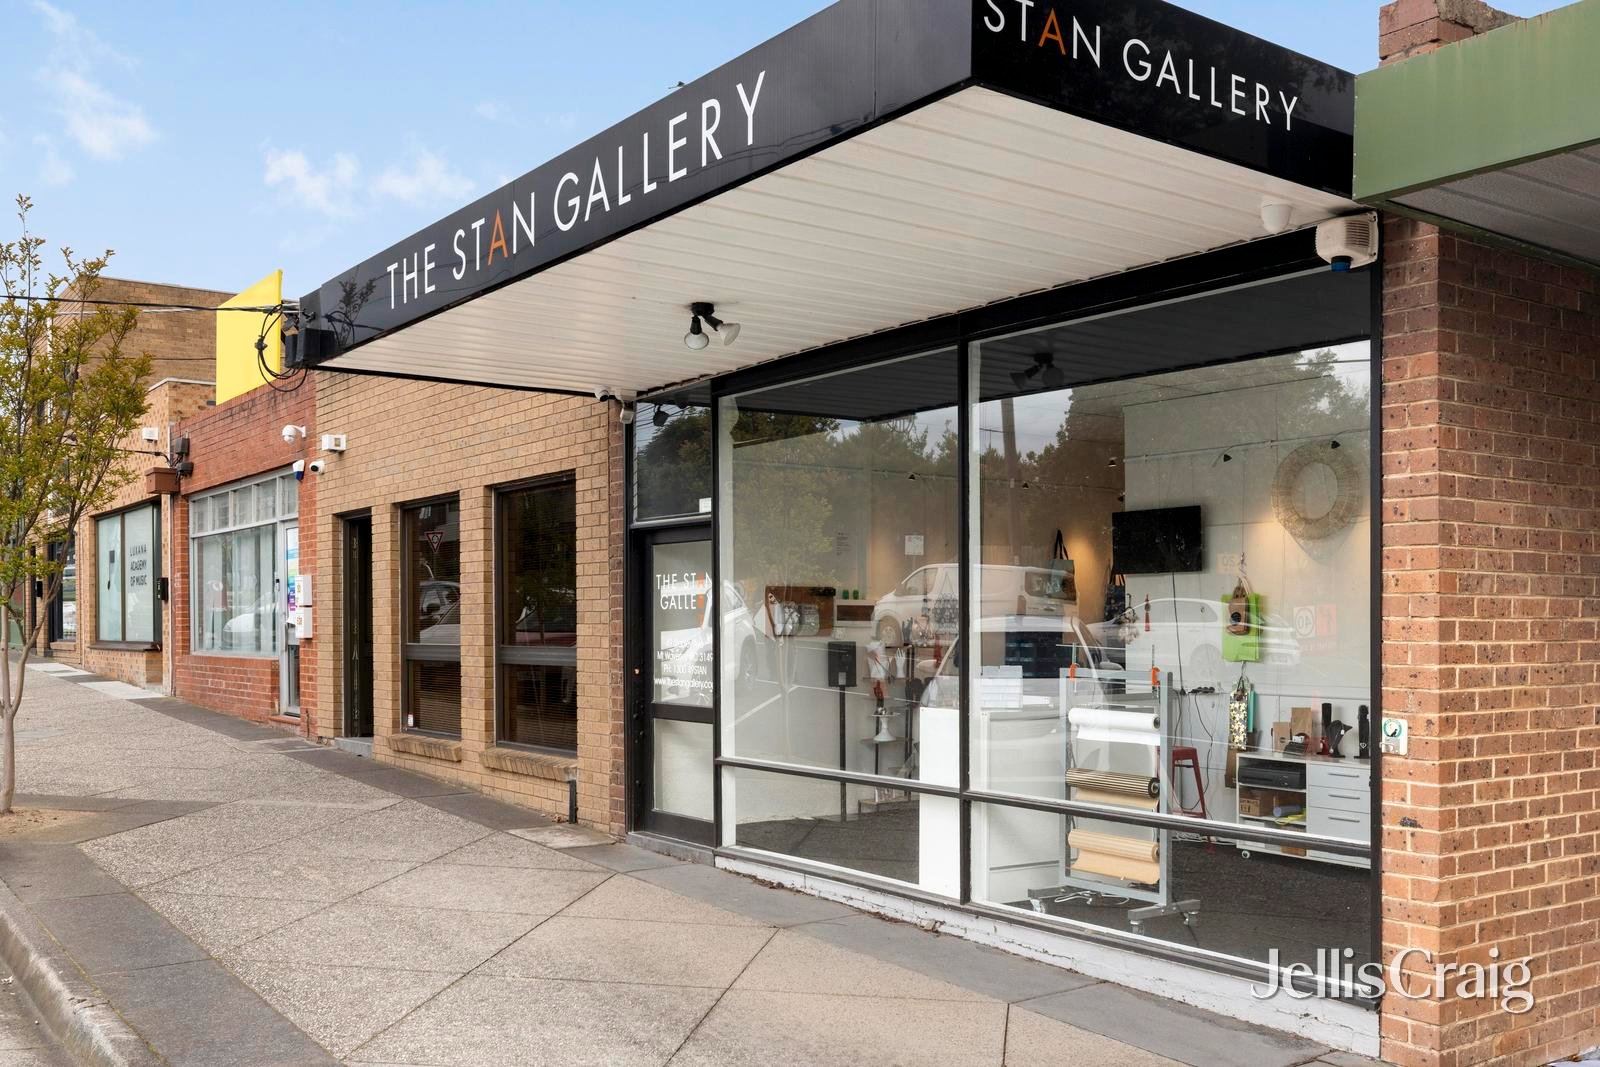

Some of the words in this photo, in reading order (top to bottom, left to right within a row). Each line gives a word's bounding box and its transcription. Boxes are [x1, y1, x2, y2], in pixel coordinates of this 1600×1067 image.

[984, 0, 1100, 68] STAN
[1123, 38, 1298, 131] GALLERY
[387, 243, 435, 309] THE
[453, 192, 535, 280] STAN
[554, 71, 765, 231] GALLERY
[656, 573, 677, 590] THE
[683, 572, 712, 590] STN
